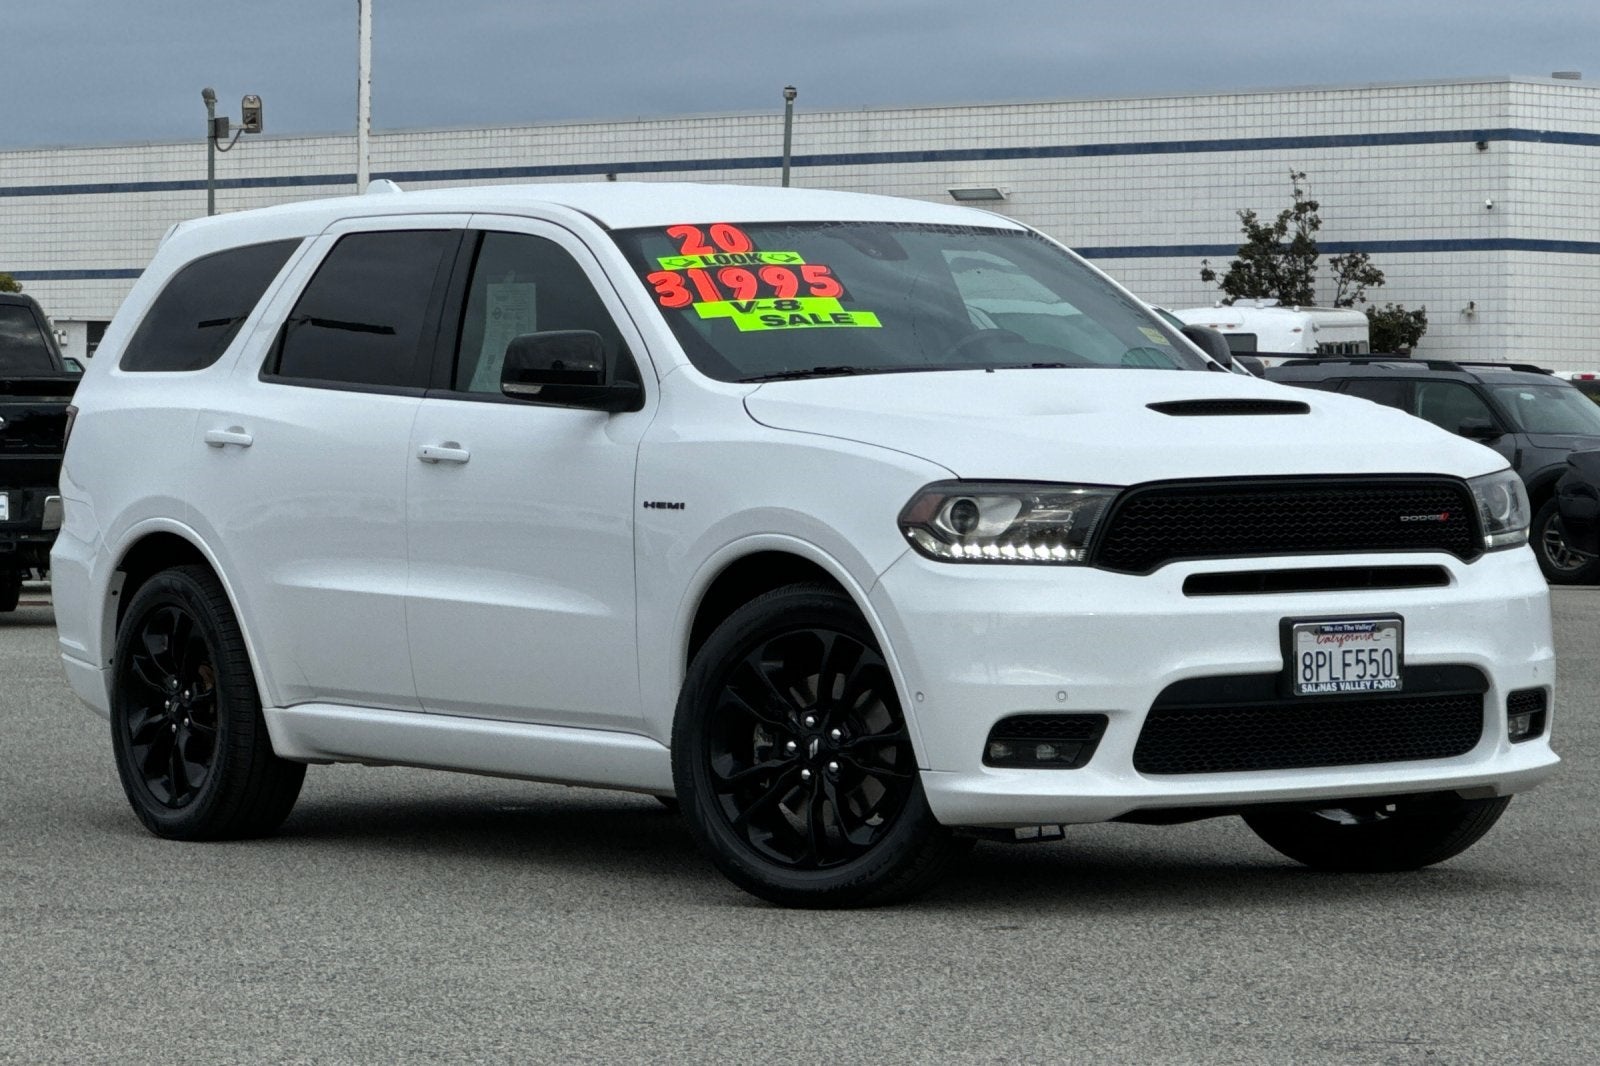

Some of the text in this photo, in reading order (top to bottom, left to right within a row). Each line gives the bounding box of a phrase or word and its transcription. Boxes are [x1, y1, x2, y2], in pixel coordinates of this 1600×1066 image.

[666, 223, 753, 255] 20
[700, 252, 766, 266] LOOK
[646, 264, 844, 309] 31995
[729, 299, 803, 314] V-8
[761, 312, 855, 328] SALE
[643, 501, 685, 510] HEMI
[1400, 514, 1441, 522] DODGE
[1302, 648, 1393, 682] 8PLF550
[1301, 679, 1397, 693] SALINAS VALLEY FORD
